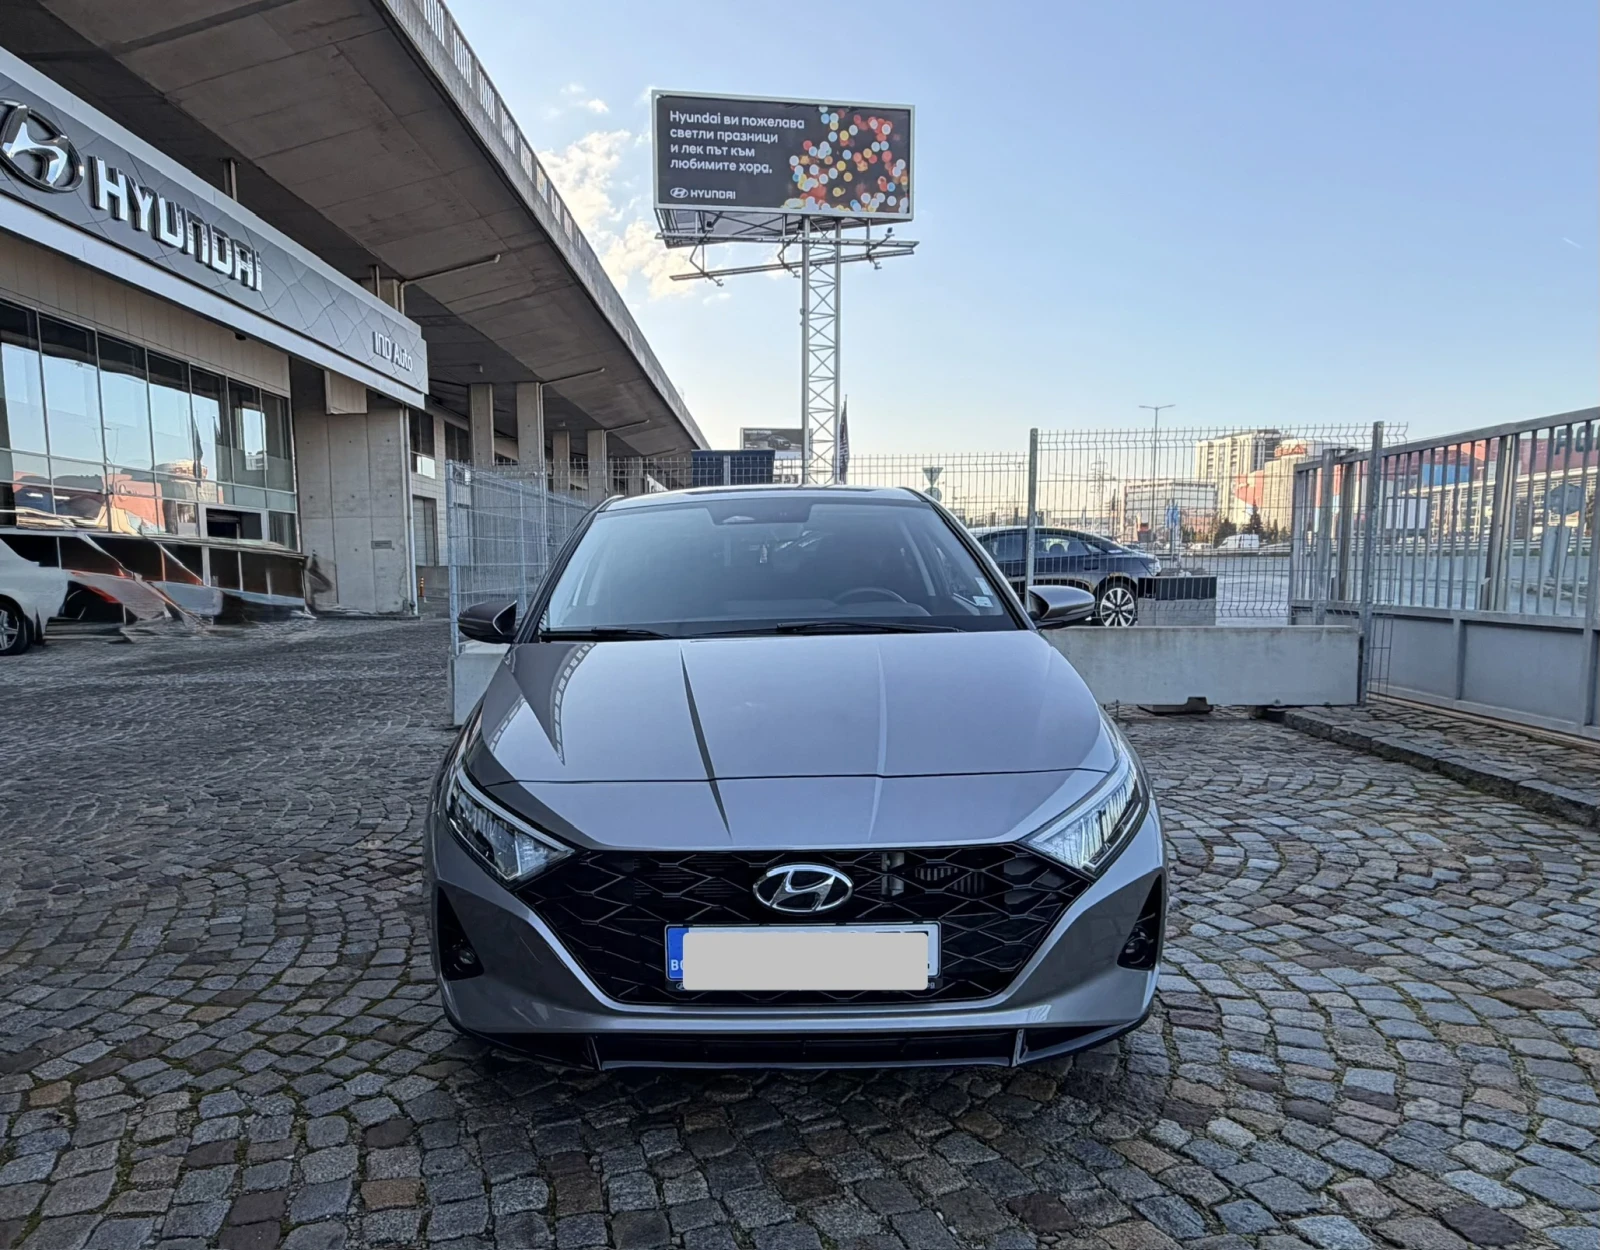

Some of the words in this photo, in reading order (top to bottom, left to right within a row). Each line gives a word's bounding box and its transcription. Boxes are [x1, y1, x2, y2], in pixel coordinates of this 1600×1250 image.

[670, 110, 721, 125] Hyundai
[723, 115, 739, 126] ви
[741, 116, 804, 129] пожелава
[670, 128, 715, 140] светли
[717, 131, 779, 144] празници
[670, 144, 679, 153] и
[681, 144, 704, 154] лек
[706, 145, 728, 156] път
[730, 147, 755, 157] към
[670, 158, 737, 171] любимите
[690, 189, 736, 200] HYUNDAI
[90, 156, 262, 292] HYUNDAI
[374, 332, 391, 360] IND
[393, 342, 413, 372] Auto
